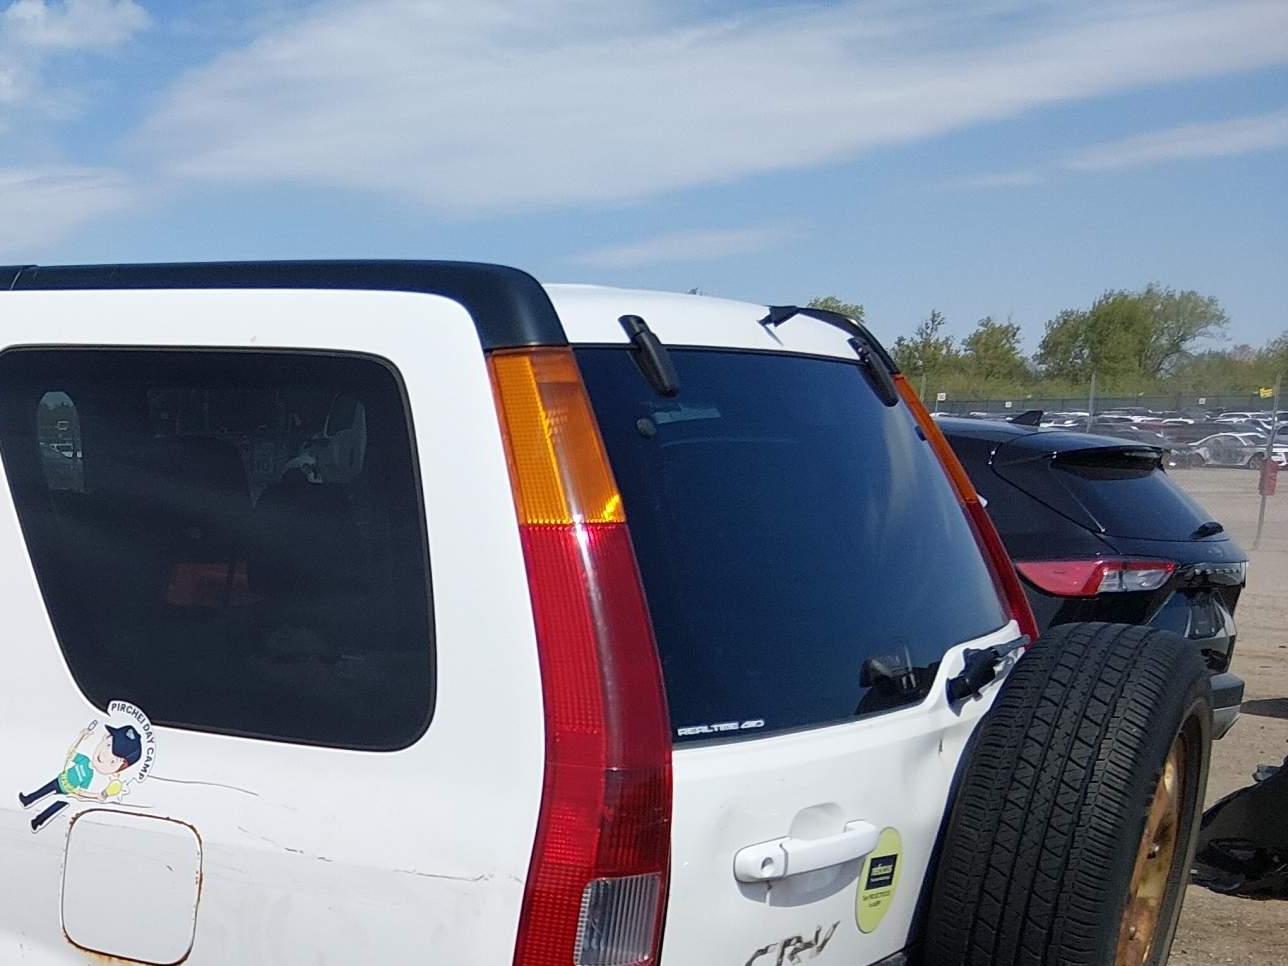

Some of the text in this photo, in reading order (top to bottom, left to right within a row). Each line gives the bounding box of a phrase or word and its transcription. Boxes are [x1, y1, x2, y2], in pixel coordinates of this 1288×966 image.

[111, 703, 154, 780] PIRCHEI DAY CAMP
